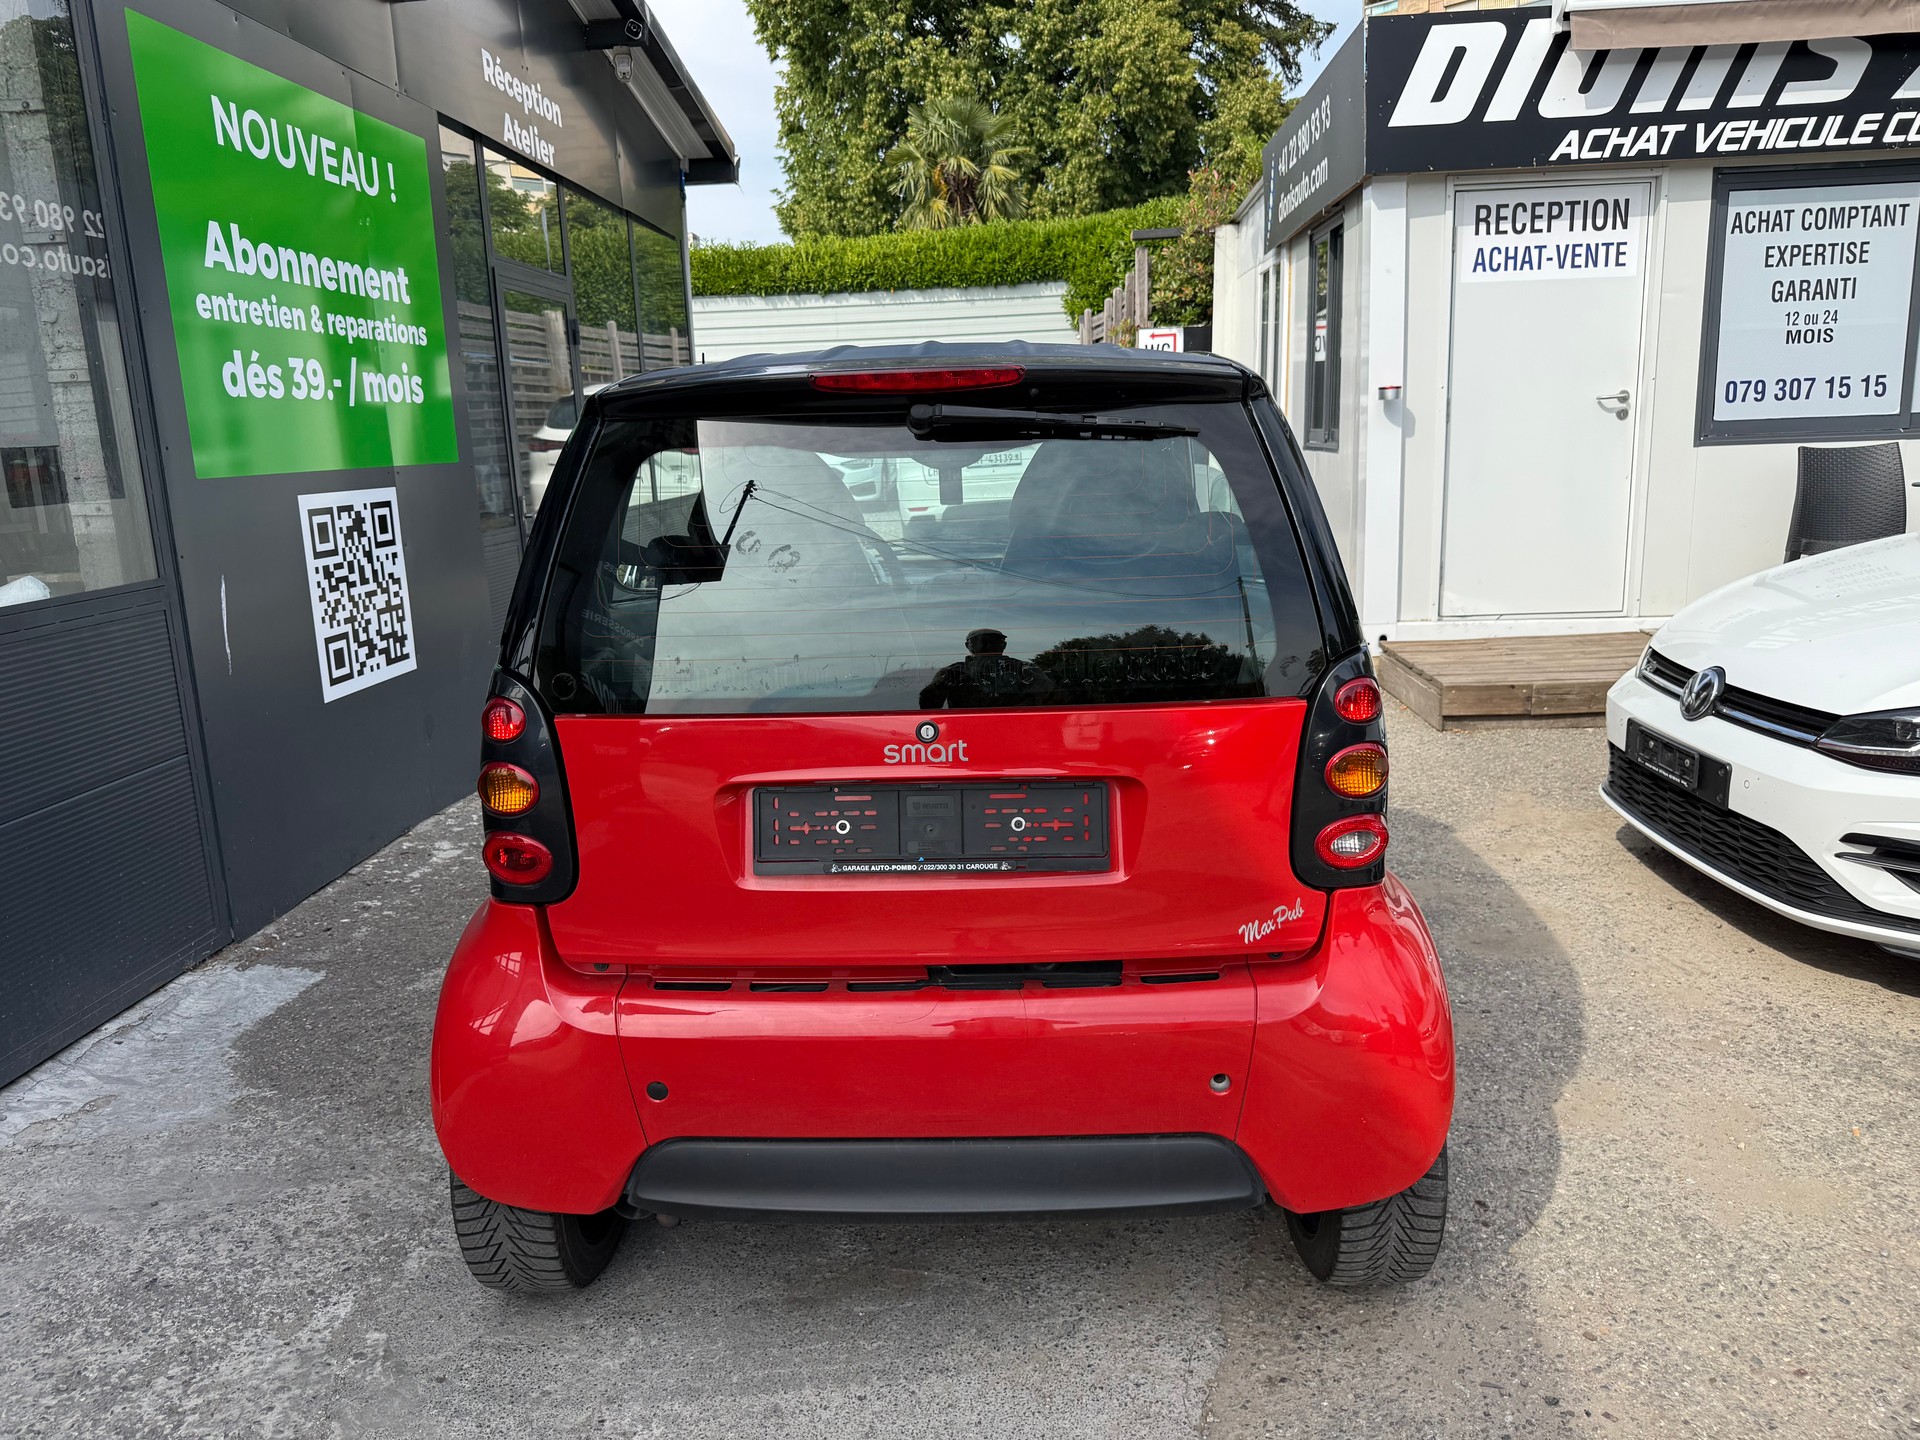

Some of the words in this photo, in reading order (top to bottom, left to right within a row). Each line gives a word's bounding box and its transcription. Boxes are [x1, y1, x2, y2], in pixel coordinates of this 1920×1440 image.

[480, 47, 563, 129] Réception
[210, 94, 380, 197] NOUVEAU
[387, 162, 397, 203] !
[503, 112, 555, 167] Atelier
[1278, 143, 1288, 177] +41
[1288, 134, 1298, 170] 22
[1297, 119, 1310, 160] 980
[1310, 107, 1321, 145] 93
[1321, 94, 1331, 133] 93
[1548, 123, 1688, 161] ACHAT
[1695, 112, 1885, 153] VEHICULE
[1278, 156, 1329, 223] dionisauto.com
[1474, 198, 1630, 236] RECEPTION
[1730, 208, 1795, 235] ACHAT
[1801, 203, 1911, 231] COMPTANT
[203, 219, 412, 305] Abonnement
[1472, 241, 1628, 273] ACHAT-VENTE
[1764, 241, 1871, 268] EXPERTISE
[1771, 277, 1857, 303] GARANTI
[195, 292, 307, 332] entretien
[310, 304, 324, 334] &
[326, 312, 428, 347] reparations
[1784, 310, 1800, 326] 12
[1803, 313, 1819, 326] ou
[1822, 309, 1839, 325] 24
[1785, 327, 1834, 345] MOIS
[222, 349, 285, 399] dés
[287, 356, 342, 401] 39.-
[361, 362, 425, 404] mois
[1724, 379, 1767, 404] 079
[1773, 377, 1817, 401] 307
[1825, 375, 1852, 399] 15
[1860, 374, 1887, 398] 15
[883, 739, 969, 764] smart
[842, 864, 870, 872] GARAGE
[870, 864, 917, 872] AUTO-POMBO
[1238, 919, 1276, 945] Max
[1272, 896, 1304, 929] Pub
